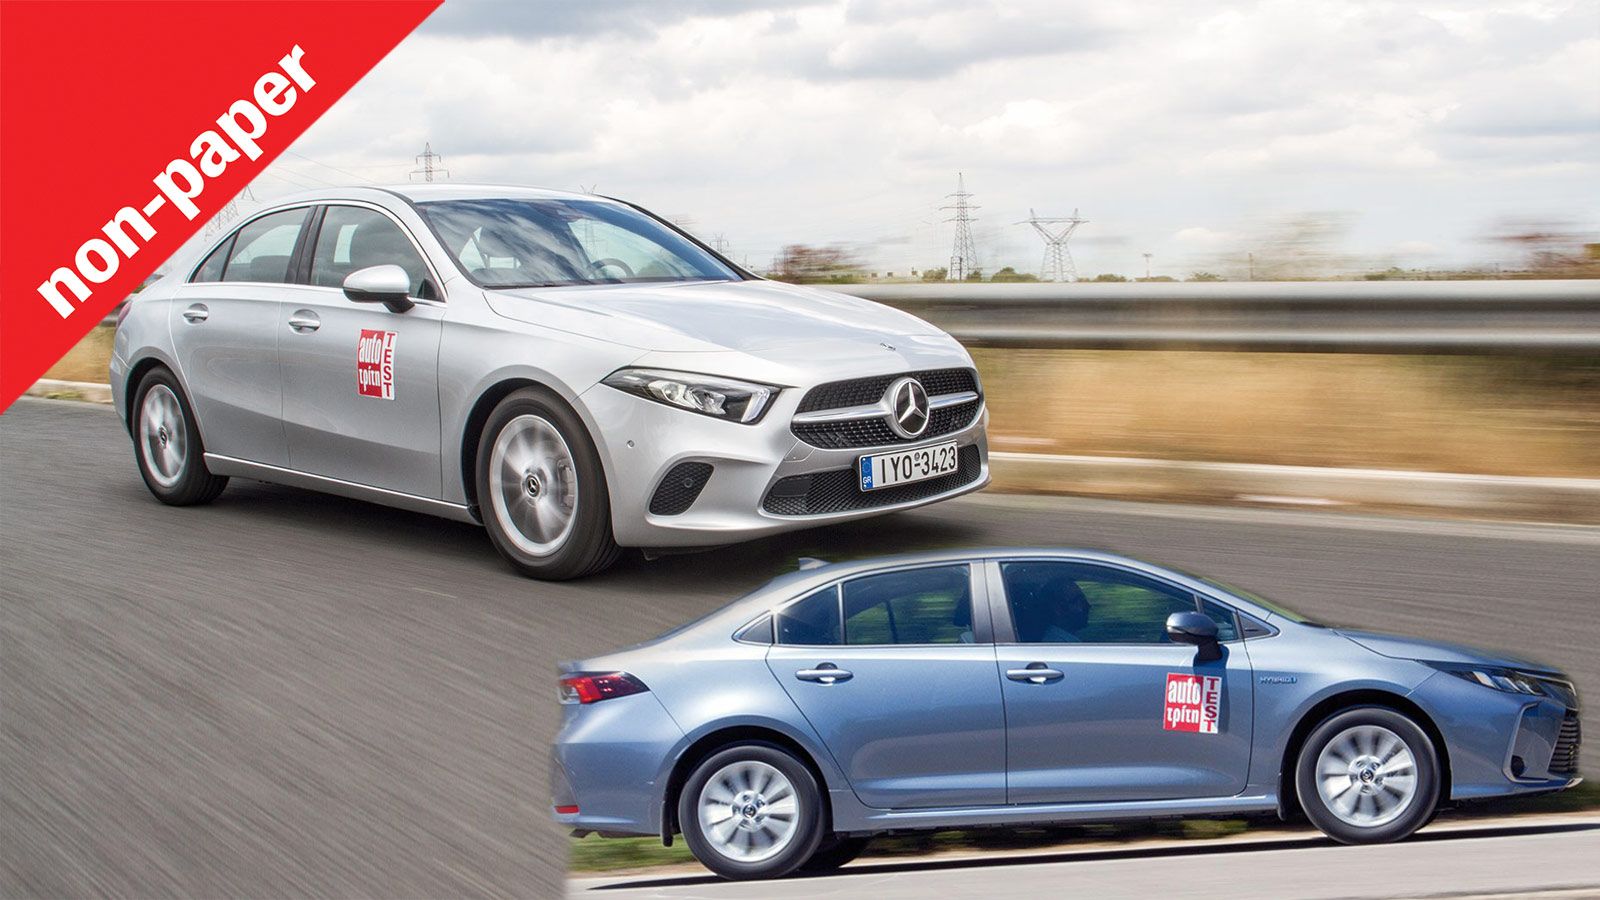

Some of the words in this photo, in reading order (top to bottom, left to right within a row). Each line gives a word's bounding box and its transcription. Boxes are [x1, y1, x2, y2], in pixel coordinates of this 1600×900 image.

[359, 333, 381, 364] auto
[383, 333, 395, 397] TEST
[862, 475, 872, 484] GR
[1168, 677, 1201, 705] auto
[1205, 678, 1219, 731] TEST
[1167, 705, 1200, 728] τρίτη
